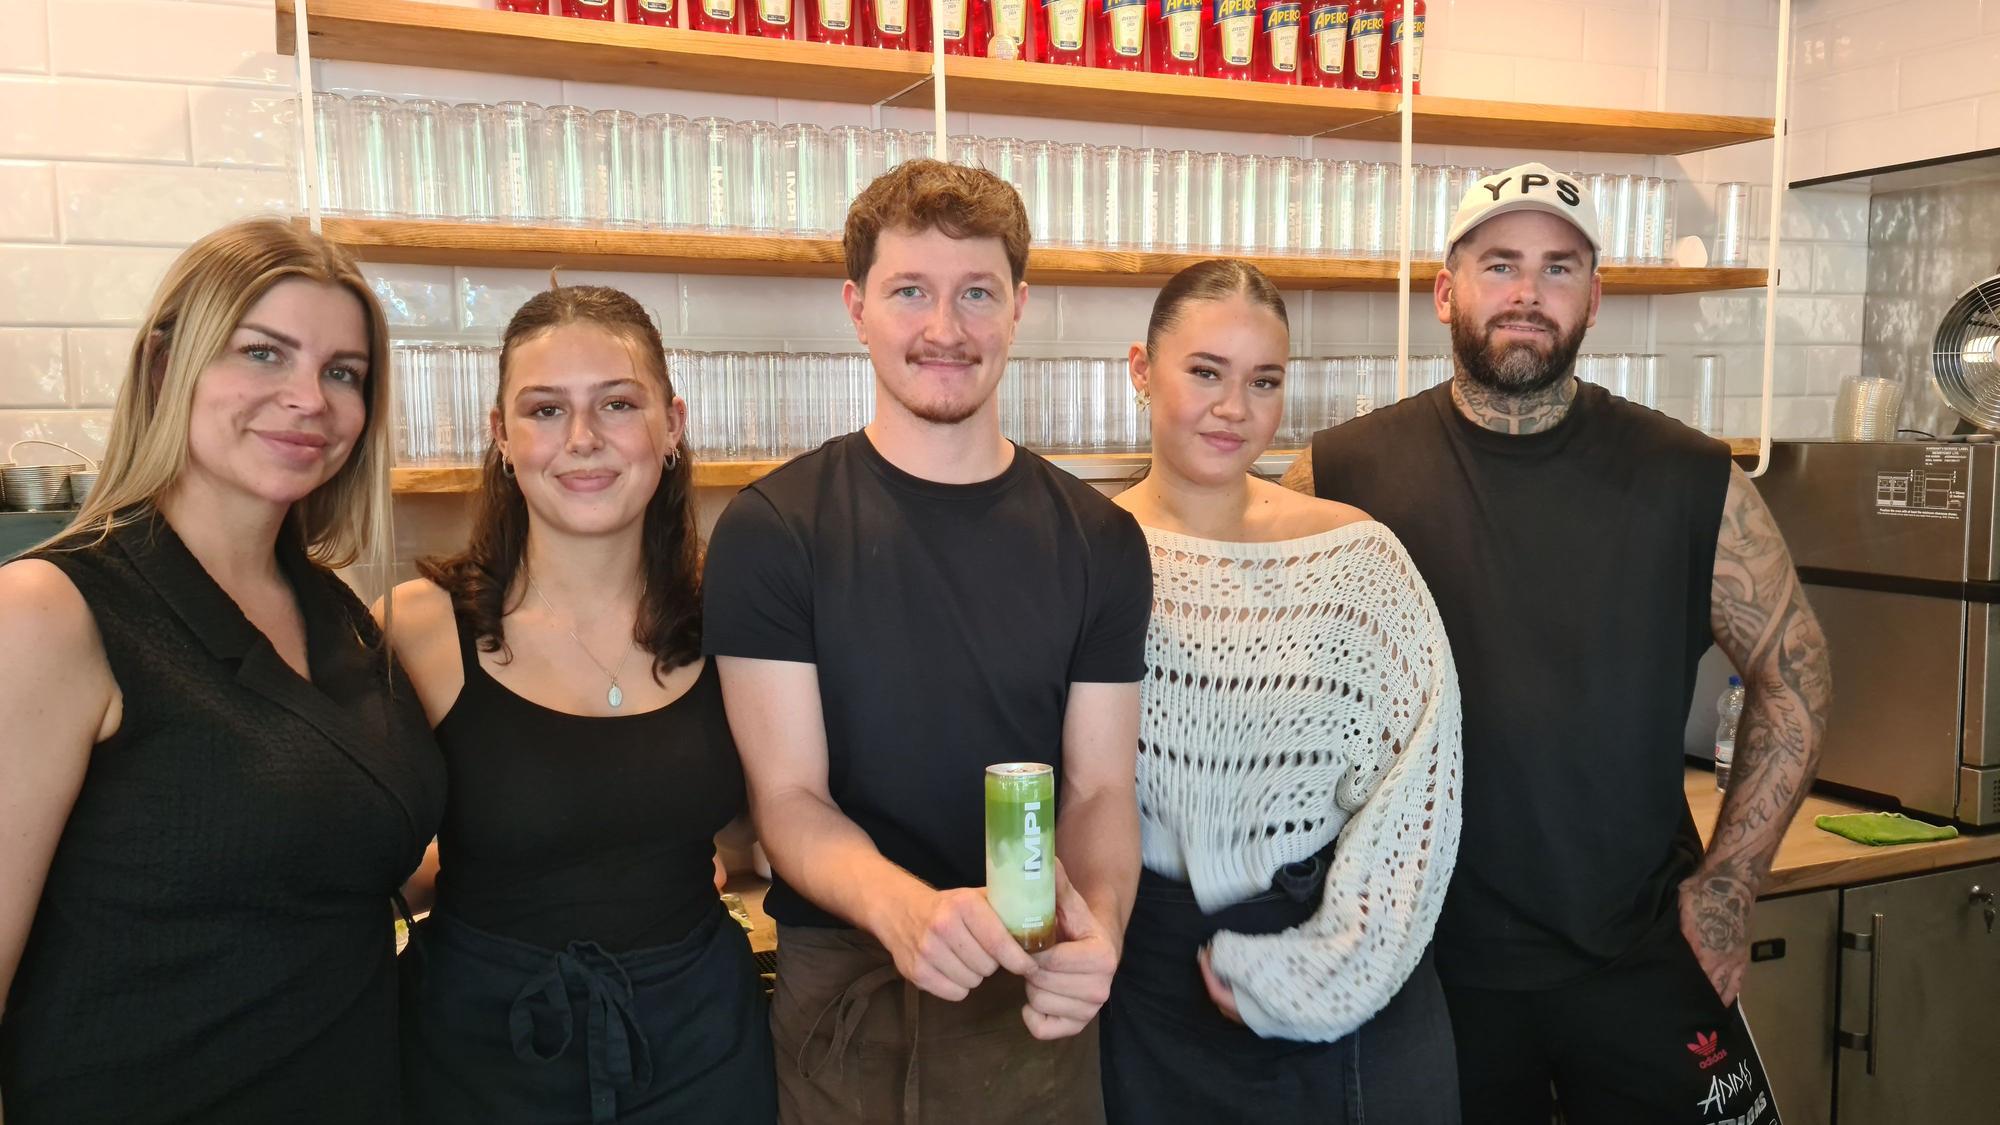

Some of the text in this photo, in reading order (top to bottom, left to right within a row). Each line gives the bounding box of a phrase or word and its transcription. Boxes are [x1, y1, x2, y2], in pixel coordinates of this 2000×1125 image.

[786, 171, 796, 221] IMPI
[1483, 173, 1581, 207] YPS
[1024, 801, 1041, 881] IMPI
[1699, 1049, 1727, 1069] adidas
